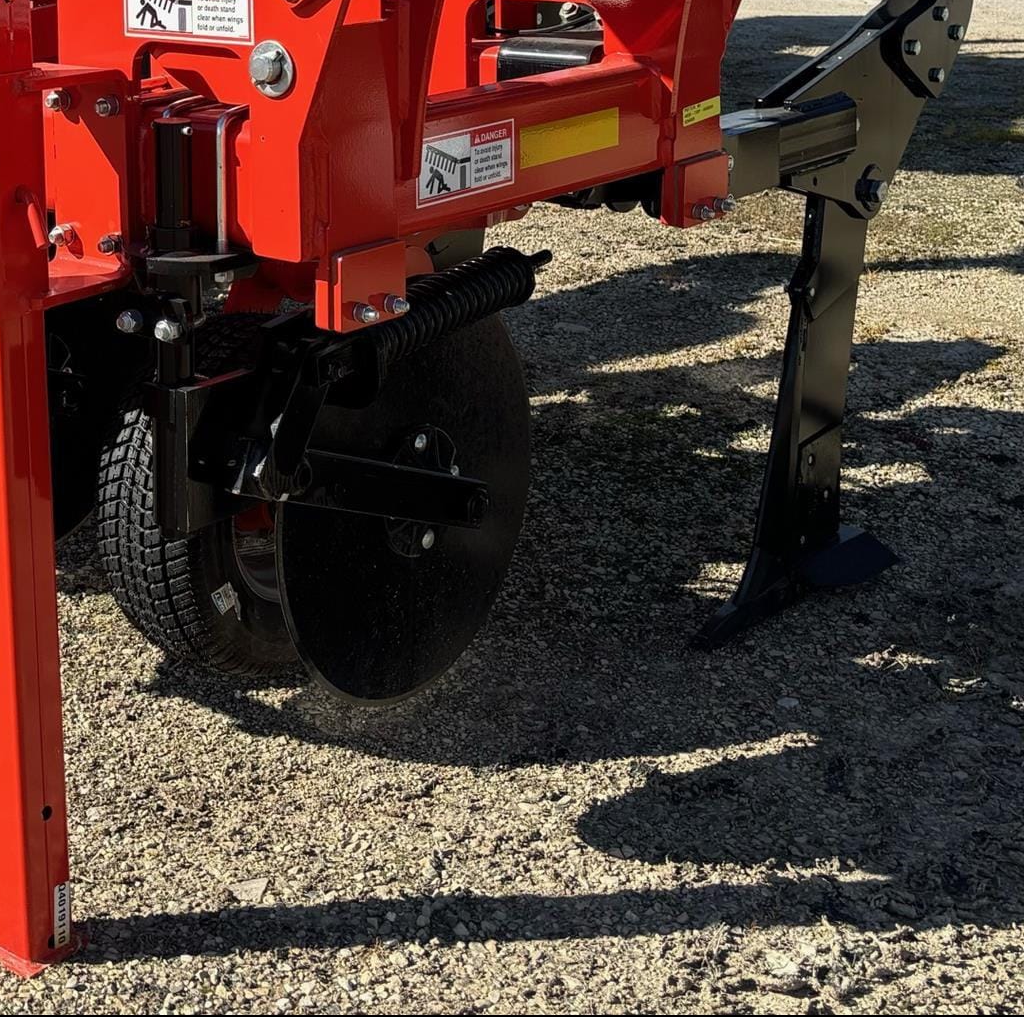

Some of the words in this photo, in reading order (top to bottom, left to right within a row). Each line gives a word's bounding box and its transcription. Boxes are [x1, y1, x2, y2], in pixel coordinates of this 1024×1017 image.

[204, 4, 219, 12] death
[227, 16, 244, 25] wings
[197, 23, 208, 31] fold
[480, 128, 508, 142] DANGER
